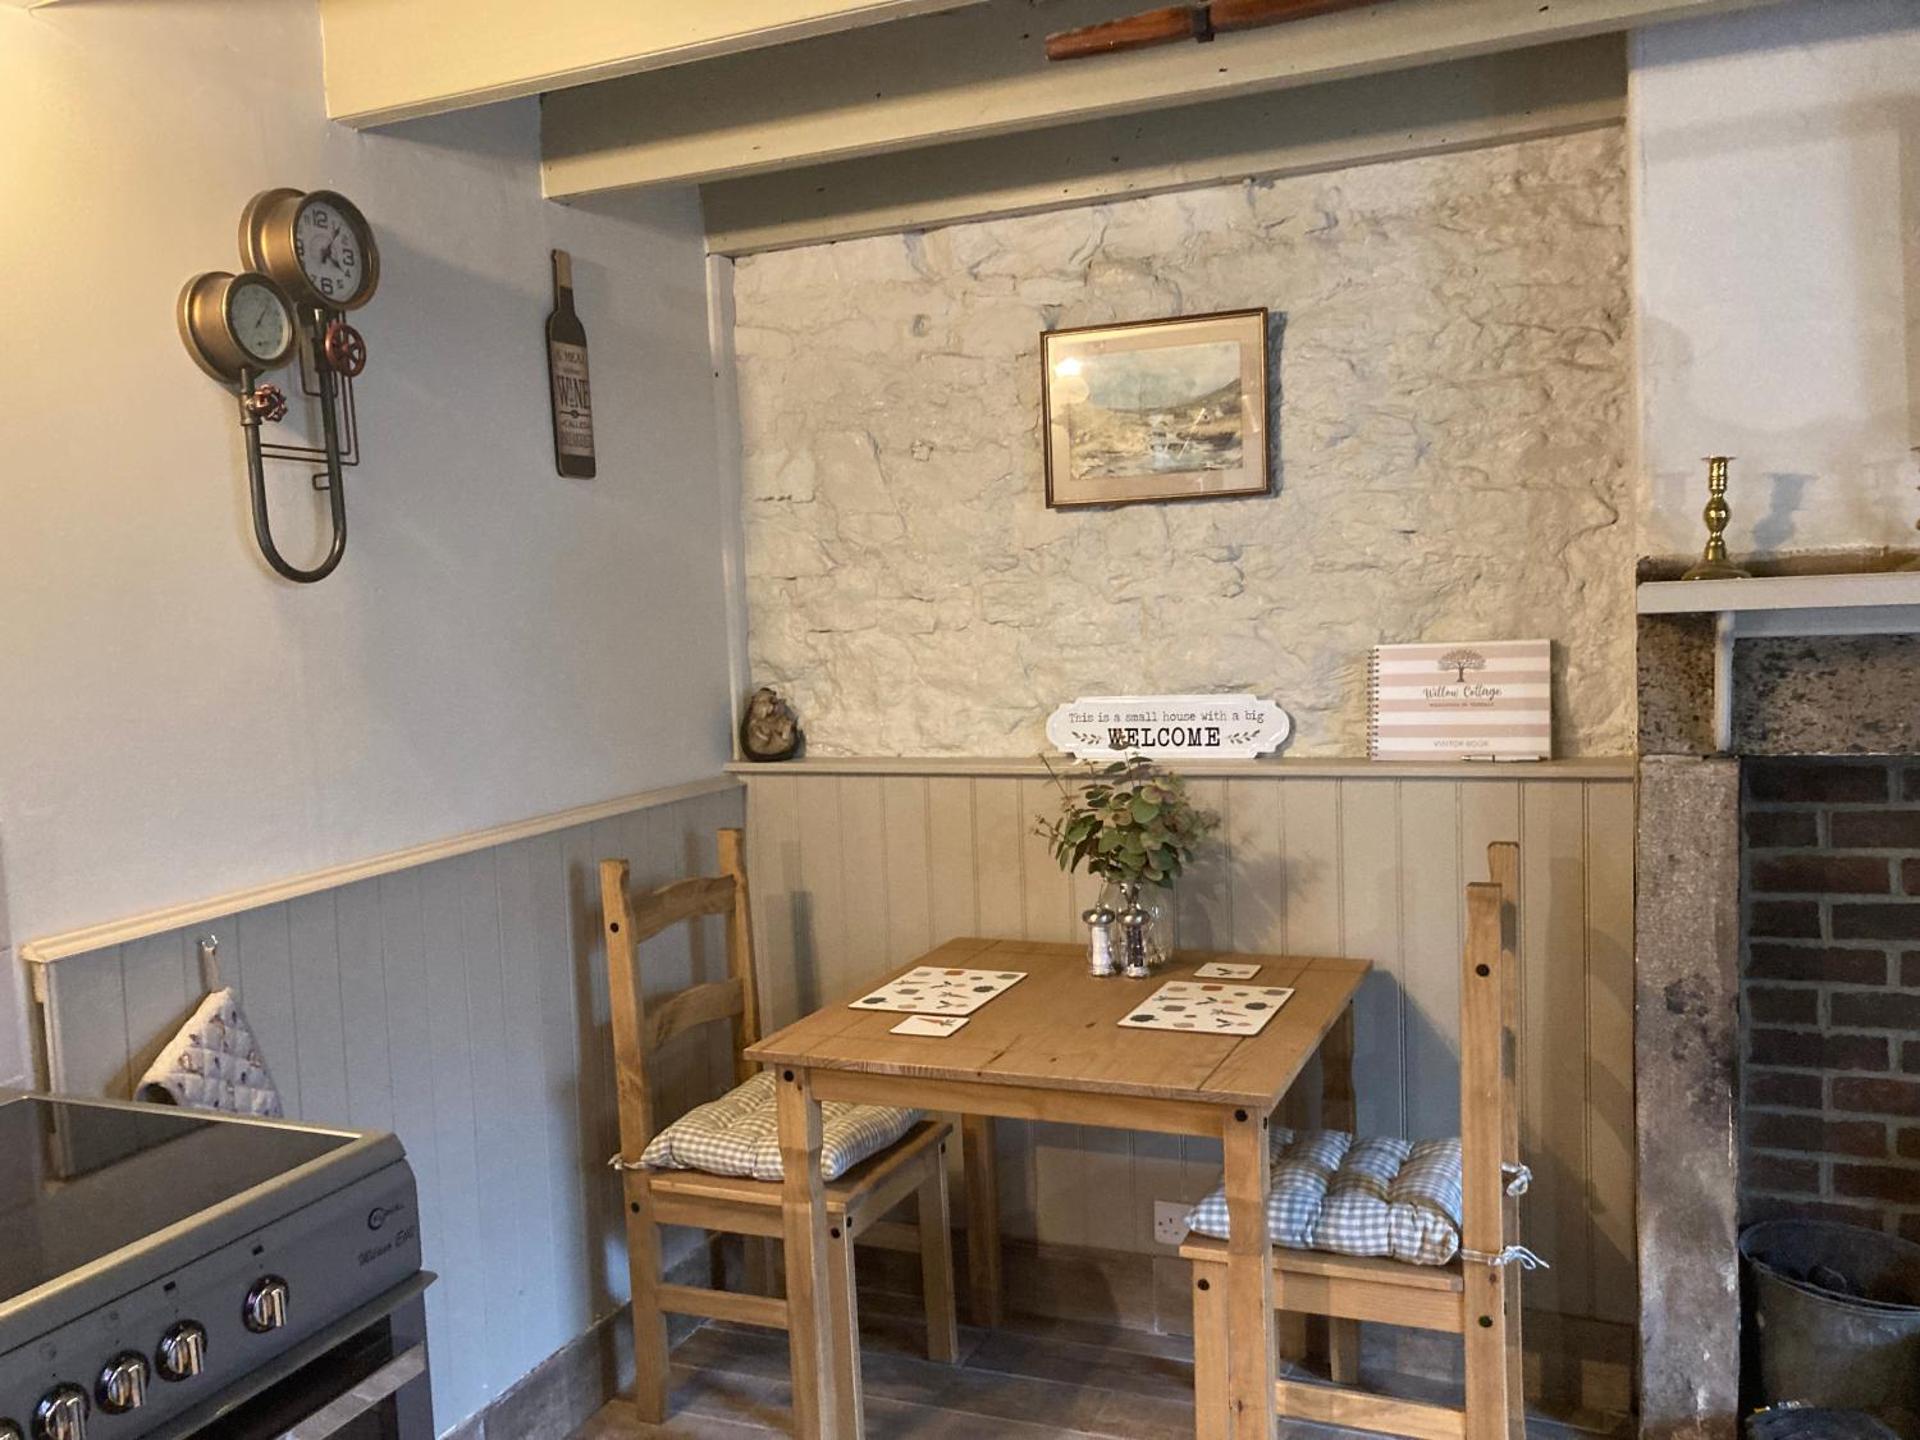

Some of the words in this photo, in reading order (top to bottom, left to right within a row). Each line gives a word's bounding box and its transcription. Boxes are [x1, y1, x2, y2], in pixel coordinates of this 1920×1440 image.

[312, 209, 328, 229] 12
[342, 248, 355, 266] 3
[320, 276, 333, 295] 6
[1423, 685, 1459, 698] Willow
[1463, 683, 1502, 700] Cottage
[1068, 712, 1094, 723] This
[1097, 712, 1110, 723] is
[1113, 714, 1120, 723] a
[1125, 711, 1157, 723] small
[1162, 711, 1196, 722] house
[1200, 710, 1227, 721] with
[1232, 712, 1239, 721] a
[1244, 710, 1264, 724] big
[1107, 727, 1221, 748] WELCOME
